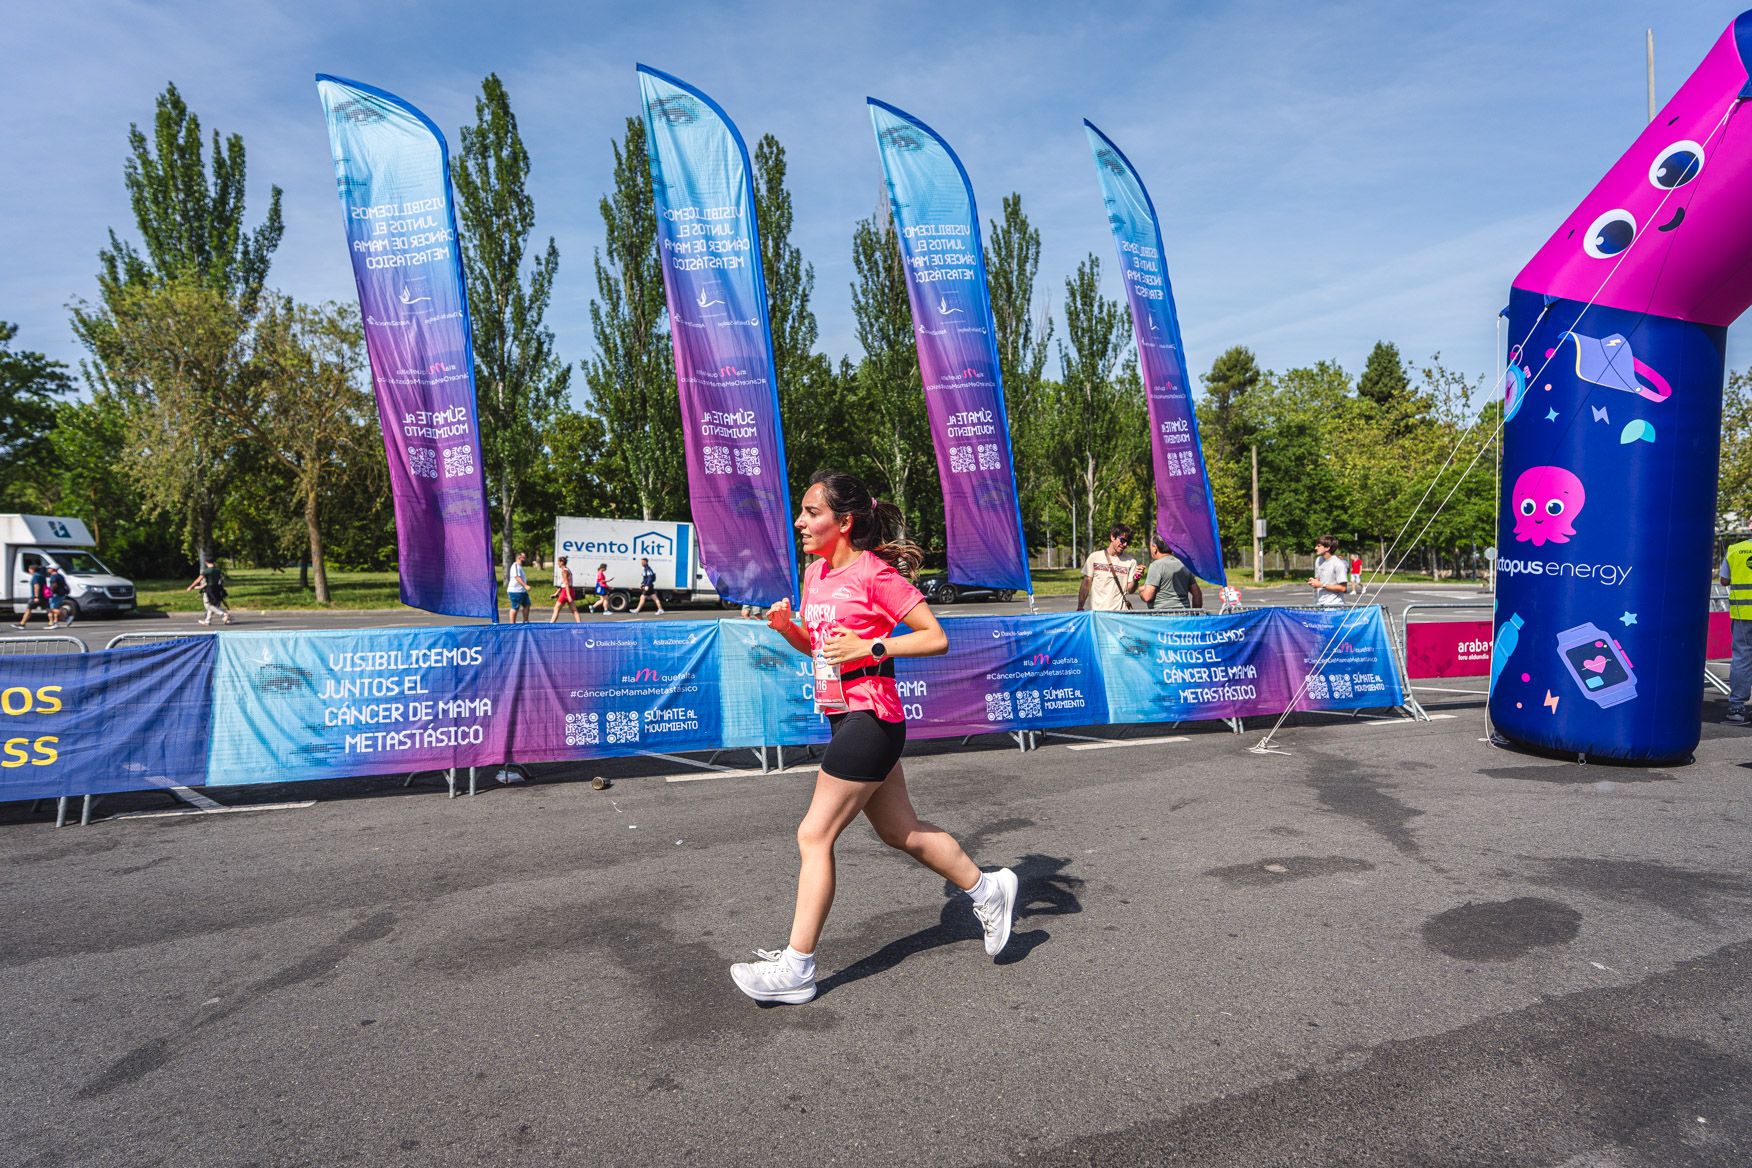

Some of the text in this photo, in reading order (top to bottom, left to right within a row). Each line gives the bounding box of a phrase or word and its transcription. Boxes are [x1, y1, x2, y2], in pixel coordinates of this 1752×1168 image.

[562, 540, 665, 555] evento kit
[1497, 556, 1633, 586] ctopus energy
[804, 603, 836, 623] ARRERA
[1158, 628, 1245, 645] VISIBILICEMOS
[1458, 638, 1489, 652] araba
[329, 646, 483, 671] VISIBILICEMOS
[1156, 649, 1222, 664] JUNTOS EL
[1163, 664, 1257, 684] CÁNCER DE MAMA
[317, 675, 428, 699] JUNTOS EL
[570, 685, 698, 698] #CáncerDeMamaMetastásico
[895, 680, 927, 697] AMA
[1043, 686, 1084, 700] SÚMATE AL
[1179, 682, 1256, 704] METASTÁSICO
[324, 698, 492, 726] CÁNCER DE MAMA
[1044, 699, 1086, 710] MOVIMIENTO
[644, 706, 698, 722] SÚMATE AL
[645, 720, 698, 733] MOVIMIENTO
[344, 723, 483, 754] METASTÁSICO
